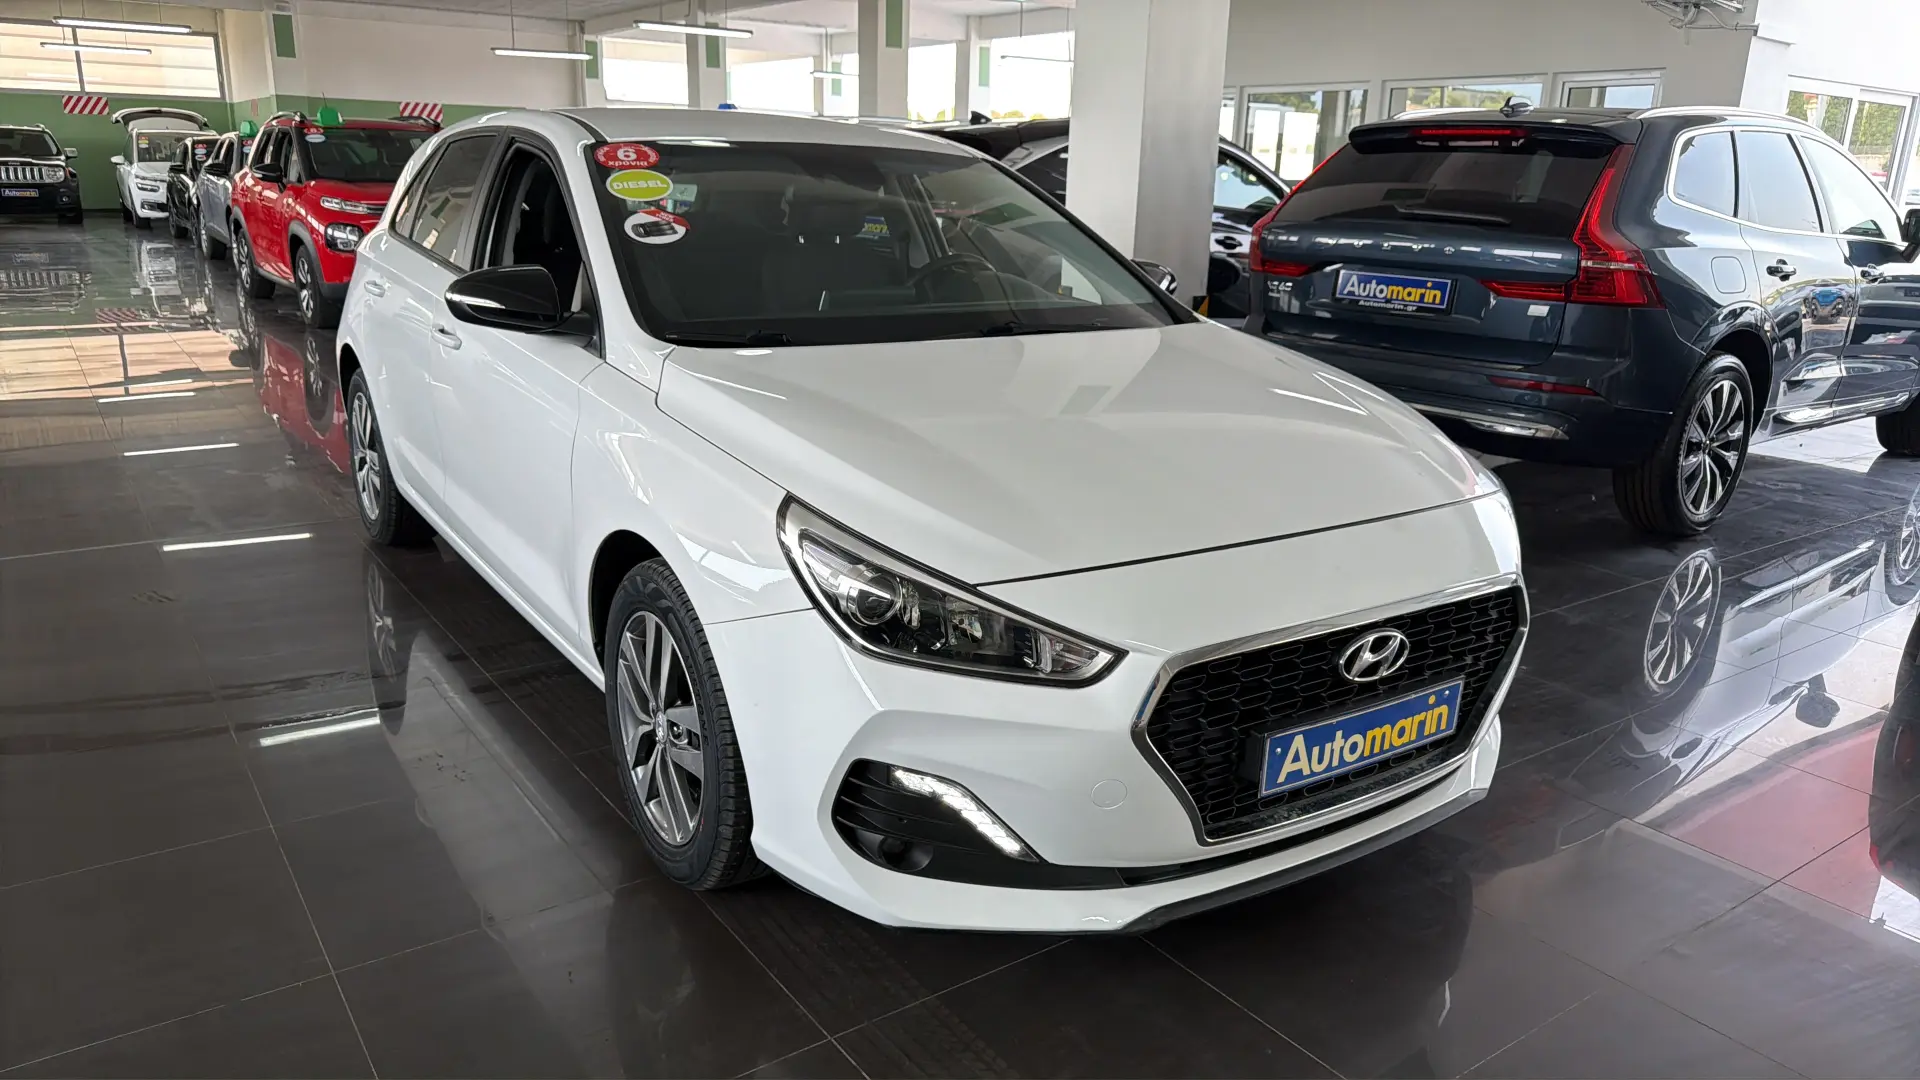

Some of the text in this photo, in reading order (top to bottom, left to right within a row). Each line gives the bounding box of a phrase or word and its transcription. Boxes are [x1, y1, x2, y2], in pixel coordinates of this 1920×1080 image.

[617, 148, 637, 160] 6
[613, 180, 667, 189] DIESEL
[1342, 274, 1442, 305] Automarin
[1358, 299, 1418, 311] Automarin.gr
[1276, 694, 1449, 784] Automarin
